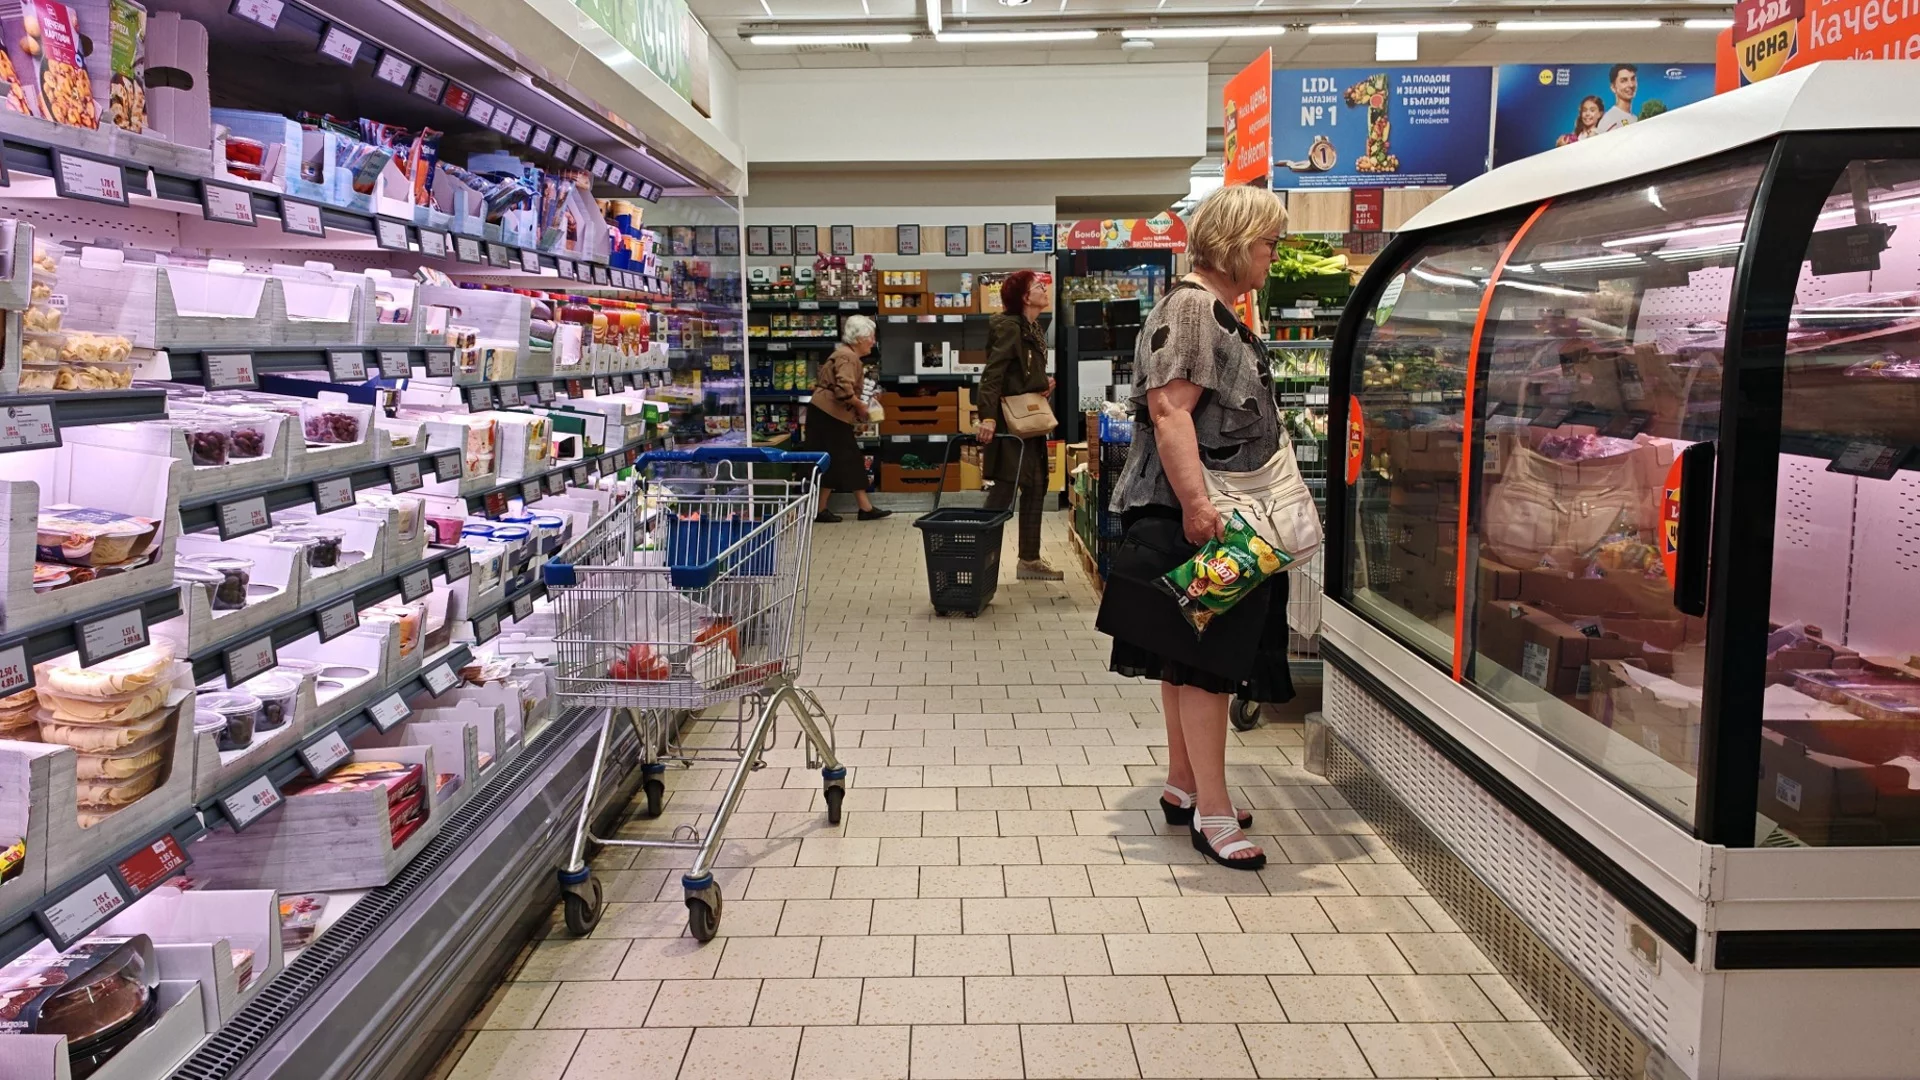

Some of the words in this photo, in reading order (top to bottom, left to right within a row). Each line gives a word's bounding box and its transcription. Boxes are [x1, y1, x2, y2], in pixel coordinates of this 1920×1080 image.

[1746, 30, 1788, 70] цена
[1302, 77, 1337, 92] LIDL
[1402, 75, 1411, 83] ЗА
[1413, 74, 1450, 84] ПЛОДОВЕ
[1404, 86, 1450, 96] ЗЕЛЕНЧУЦИ
[1302, 96, 1337, 104] МАГАЗИН
[1410, 97, 1450, 106] БЪЛГАРИЯ
[1328, 106, 1337, 126] 1
[1417, 108, 1450, 116] продажби
[1210, 560, 1237, 582] Lay's
[93, 895, 105, 906] 7.15
[99, 901, 113, 914] 13.98
